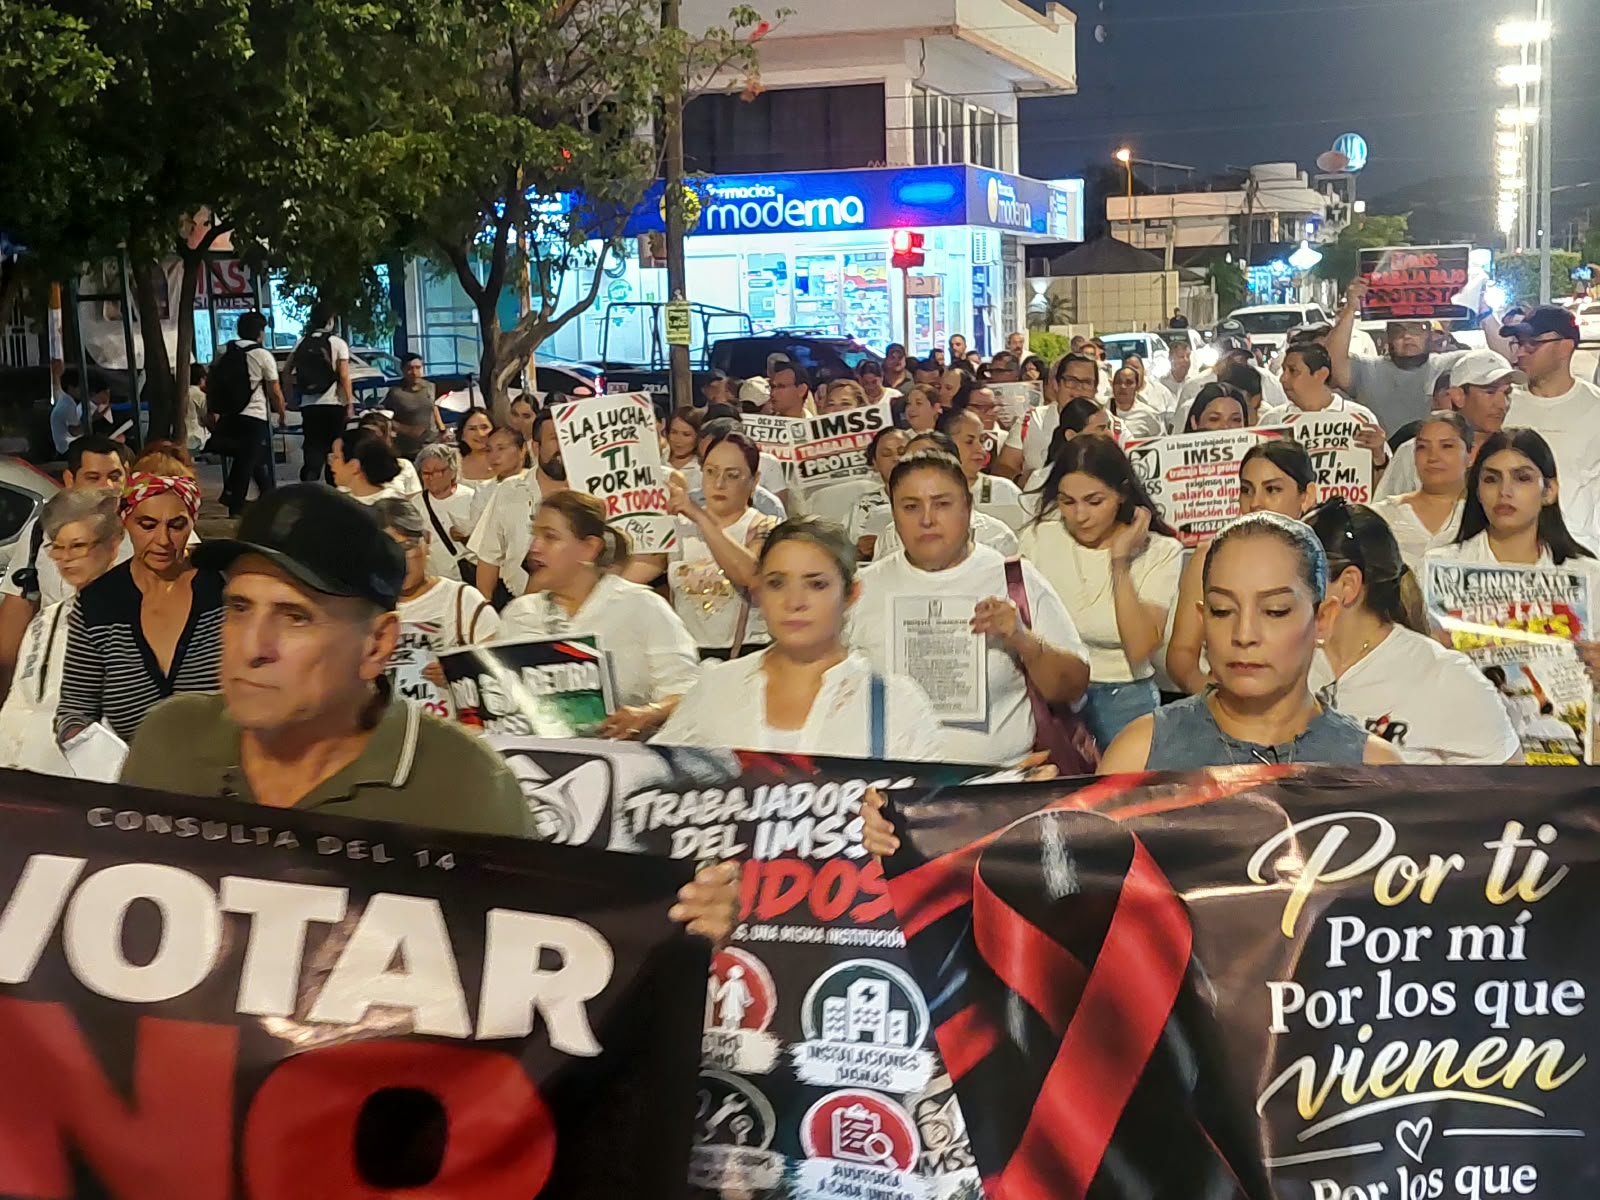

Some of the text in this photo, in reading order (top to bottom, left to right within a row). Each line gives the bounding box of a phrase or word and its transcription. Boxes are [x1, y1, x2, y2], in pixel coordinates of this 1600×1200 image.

[707, 194, 864, 230] moderna
[570, 406, 647, 442] LA LUCHA
[591, 425, 640, 449] ES POR
[811, 408, 883, 440] IMSS
[1299, 424, 1310, 440] A
[1184, 446, 1234, 465] IMSS
[1305, 437, 1349, 449] ES POR
[601, 446, 637, 471] TI,
[804, 451, 868, 476] PROTES
[1310, 451, 1342, 469] TI,
[586, 466, 657, 495] POR MI,
[1335, 468, 1360, 484] MI,
[623, 488, 668, 512] TODOS
[1172, 486, 1213, 502] salario
[1226, 504, 1240, 518] dig
[87, 807, 456, 871] CONSULTA DEL 14
[671, 816, 870, 860] DEL IMSS
[1247, 811, 1569, 938] Por ti
[739, 859, 894, 922] IDOS
[1326, 909, 1533, 968] Por mí
[1266, 969, 1585, 1034] Por los que
[1255, 1023, 1587, 1120] vienen
[0, 994, 556, 1200] NO
[1396, 1165, 1443, 1200] los
[1454, 1164, 1538, 1200] que
